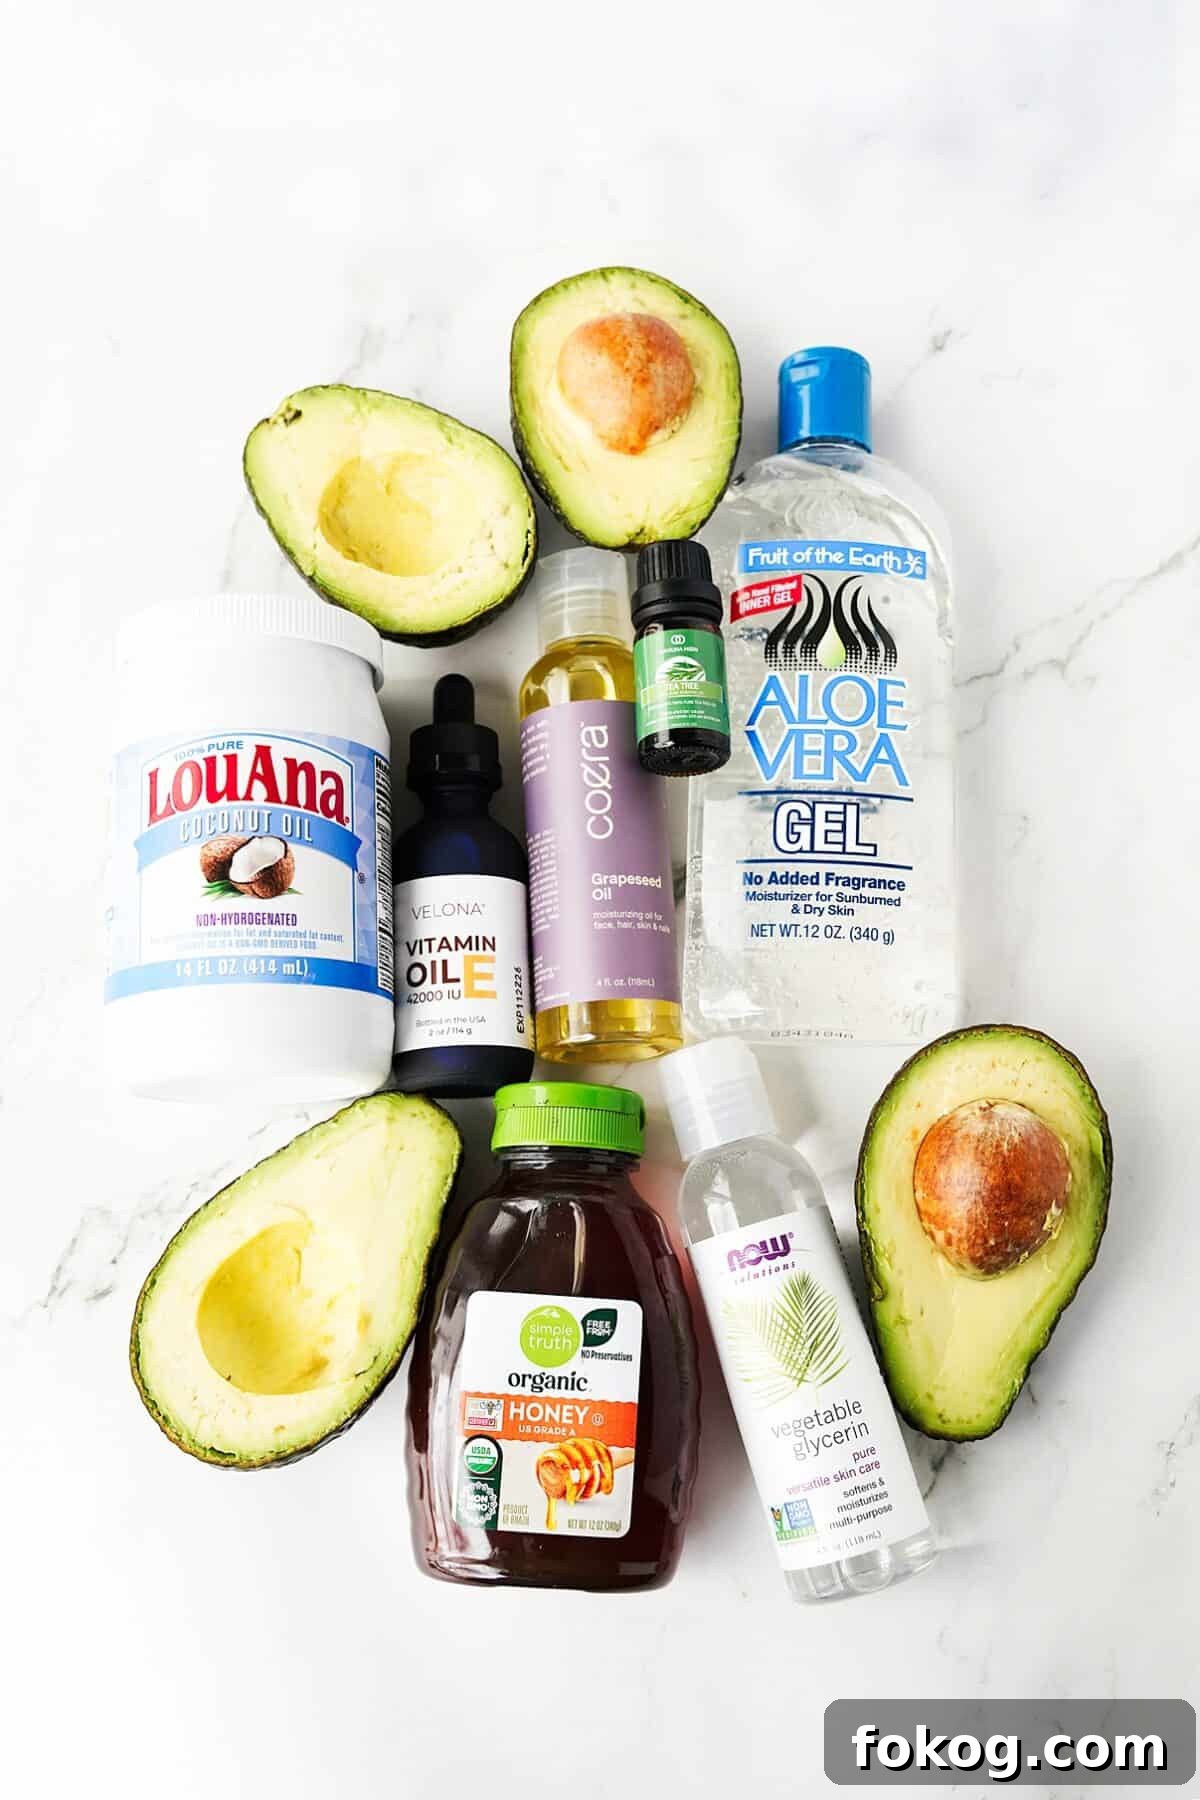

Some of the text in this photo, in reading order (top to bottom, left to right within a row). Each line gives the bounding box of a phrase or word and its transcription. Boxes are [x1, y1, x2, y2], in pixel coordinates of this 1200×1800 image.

[749, 546, 904, 571] Fruit of the Earth
[773, 590, 794, 606] GEL
[745, 674, 908, 731] ALOE
[207, 740, 244, 752] PURE
[745, 728, 911, 787] VERA
[147, 744, 347, 827] LouAna
[180, 809, 314, 842] COCONUT OIL
[772, 799, 878, 857] GEL
[591, 873, 662, 888] Grapeseed
[742, 871, 906, 891] No Added Fragrance
[591, 888, 612, 901] Oil
[745, 890, 902, 907] Moisturizer for Sunburned
[196, 911, 298, 927] NON-HYDROGENATED
[411, 902, 482, 920] VELONA
[592, 909, 663, 921] moisturizing oil for
[791, 904, 854, 917] & Dry Skin
[273, 929, 307, 939] saturated
[637, 921, 652, 929] skin
[750, 924, 776, 938] NET
[824, 925, 846, 939] OZ.
[849, 926, 879, 943] (340
[882, 929, 895, 945] g)
[406, 936, 497, 957] VITAMIN
[175, 959, 309, 977] 14 FL OZ (414 mL)
[406, 959, 461, 988] OIL
[463, 954, 497, 1000] E
[406, 989, 461, 1005] 42000 IU
[453, 1016, 468, 1025] the
[469, 1015, 486, 1025] USA
[734, 1261, 797, 1287] solutions
[529, 1324, 574, 1337] simple
[586, 1319, 611, 1329] FREE
[528, 1336, 572, 1350] truth
[581, 1350, 633, 1362] NO Preservatives
[508, 1370, 588, 1393] organic
[509, 1400, 590, 1425] HONEY
[771, 1399, 863, 1439] vegetable
[518, 1425, 531, 1433] US
[533, 1426, 568, 1436] GRADE
[793, 1420, 870, 1461] glycerin
[471, 1446, 491, 1455] USDA
[852, 1445, 877, 1464] pure
[786, 1459, 881, 1496] versatile skin care
[843, 1476, 885, 1498] softens &
[837, 1490, 889, 1513] moisturizes
[829, 1503, 893, 1530] multi-purpose
